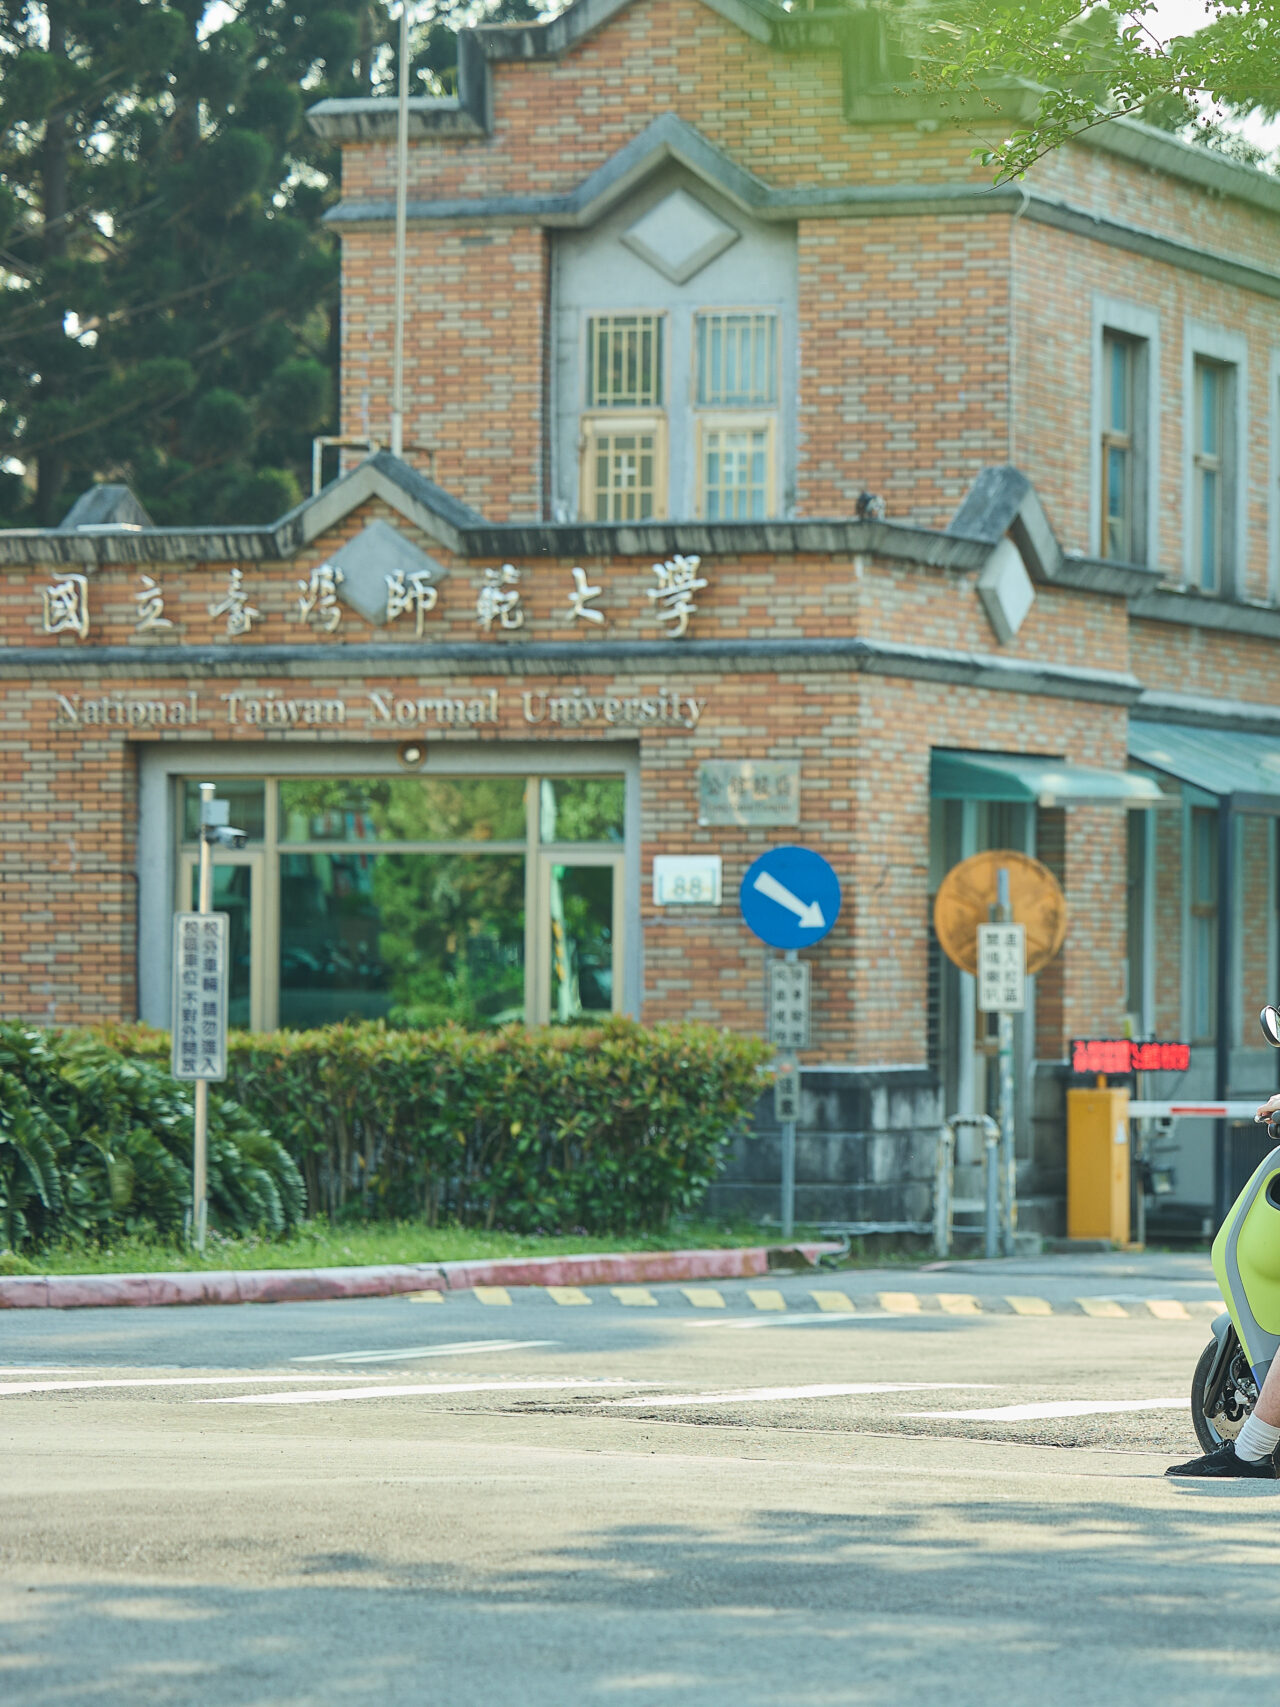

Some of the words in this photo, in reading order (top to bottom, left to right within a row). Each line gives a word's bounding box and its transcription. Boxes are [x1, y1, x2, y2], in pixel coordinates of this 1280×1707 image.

[56, 690, 199, 725] National
[221, 689, 346, 725] Taiwan
[369, 688, 499, 723] Normal
[521, 687, 706, 728] University
[673, 875, 703, 898] 88
